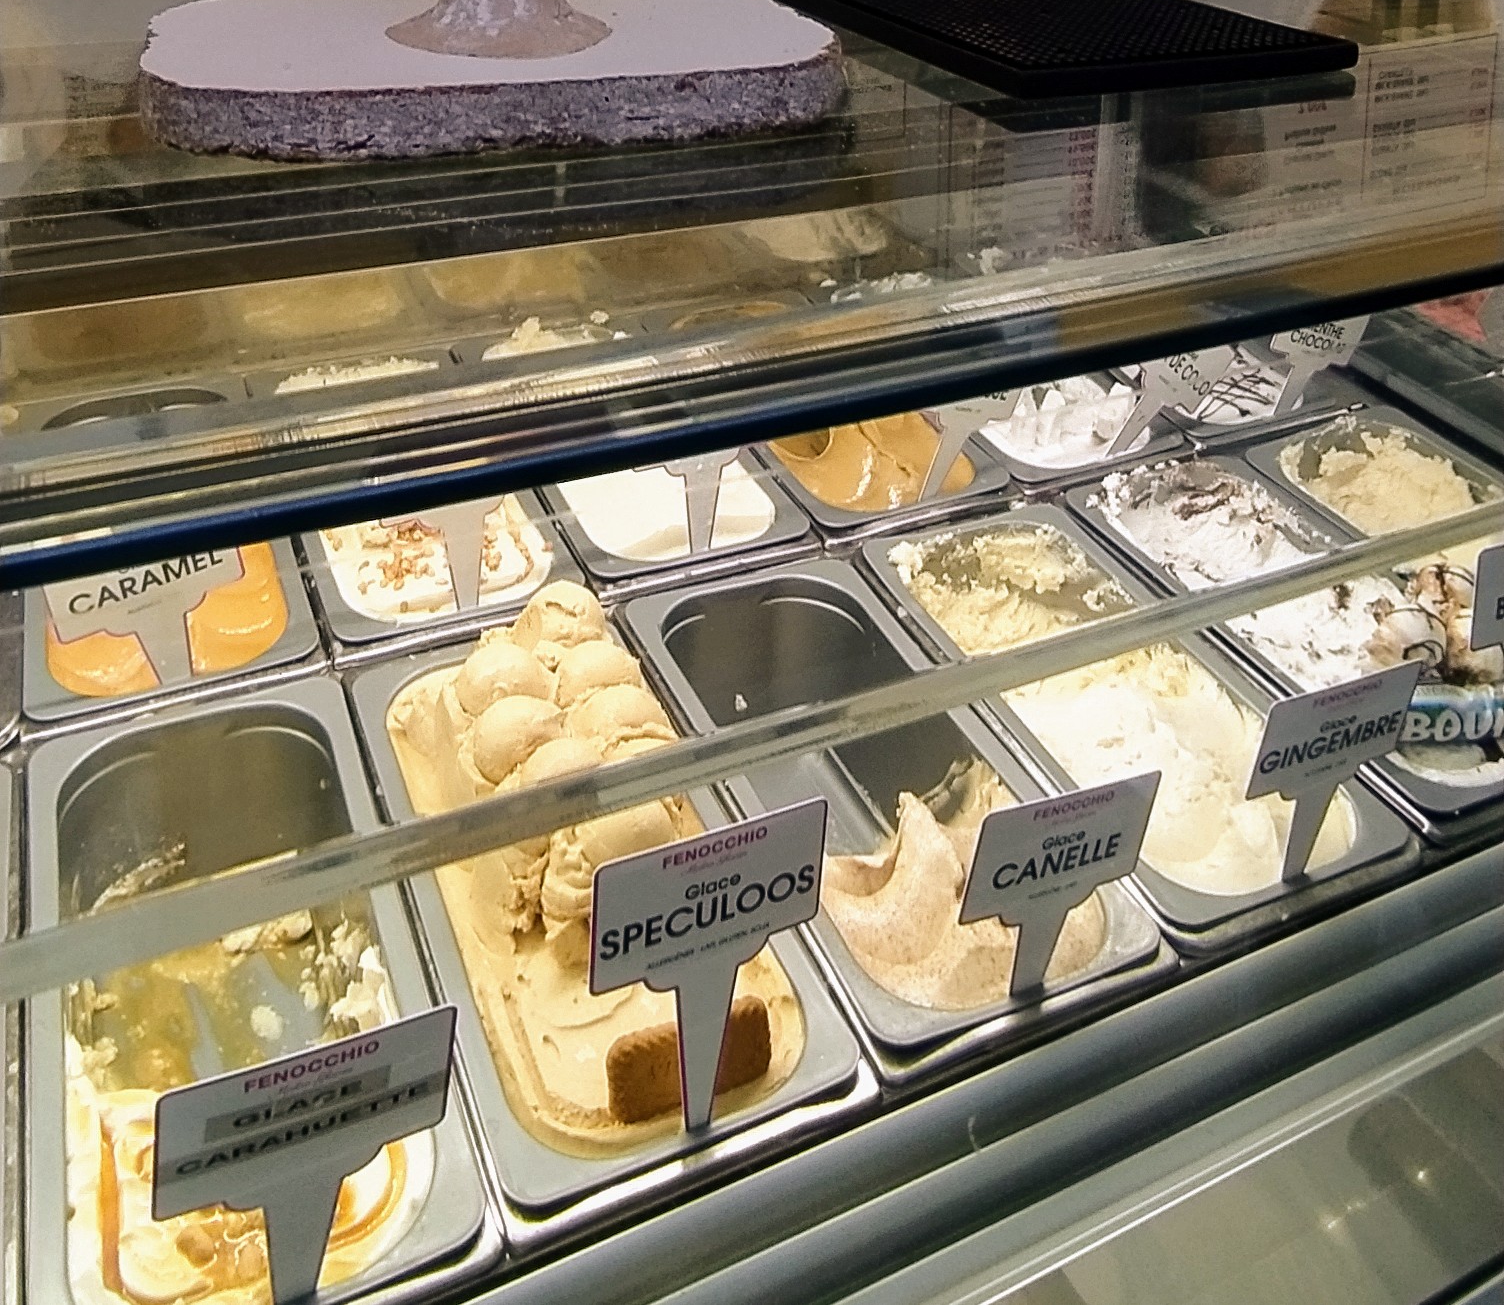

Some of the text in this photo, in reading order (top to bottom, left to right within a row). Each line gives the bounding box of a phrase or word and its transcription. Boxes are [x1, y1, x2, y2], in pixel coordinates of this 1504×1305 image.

[68, 550, 224, 615] CARAMEL
[1260, 710, 1402, 774] GINGEMBRE
[1033, 790, 1115, 821] FENOCCHIO
[662, 826, 768, 870] FENOCCHIO
[992, 832, 1122, 891] CANELLE
[1042, 830, 1086, 851] Glace
[600, 863, 815, 962] SPECULOOS
[685, 873, 742, 900] Glace
[244, 1039, 381, 1094] FENOCCHIO
